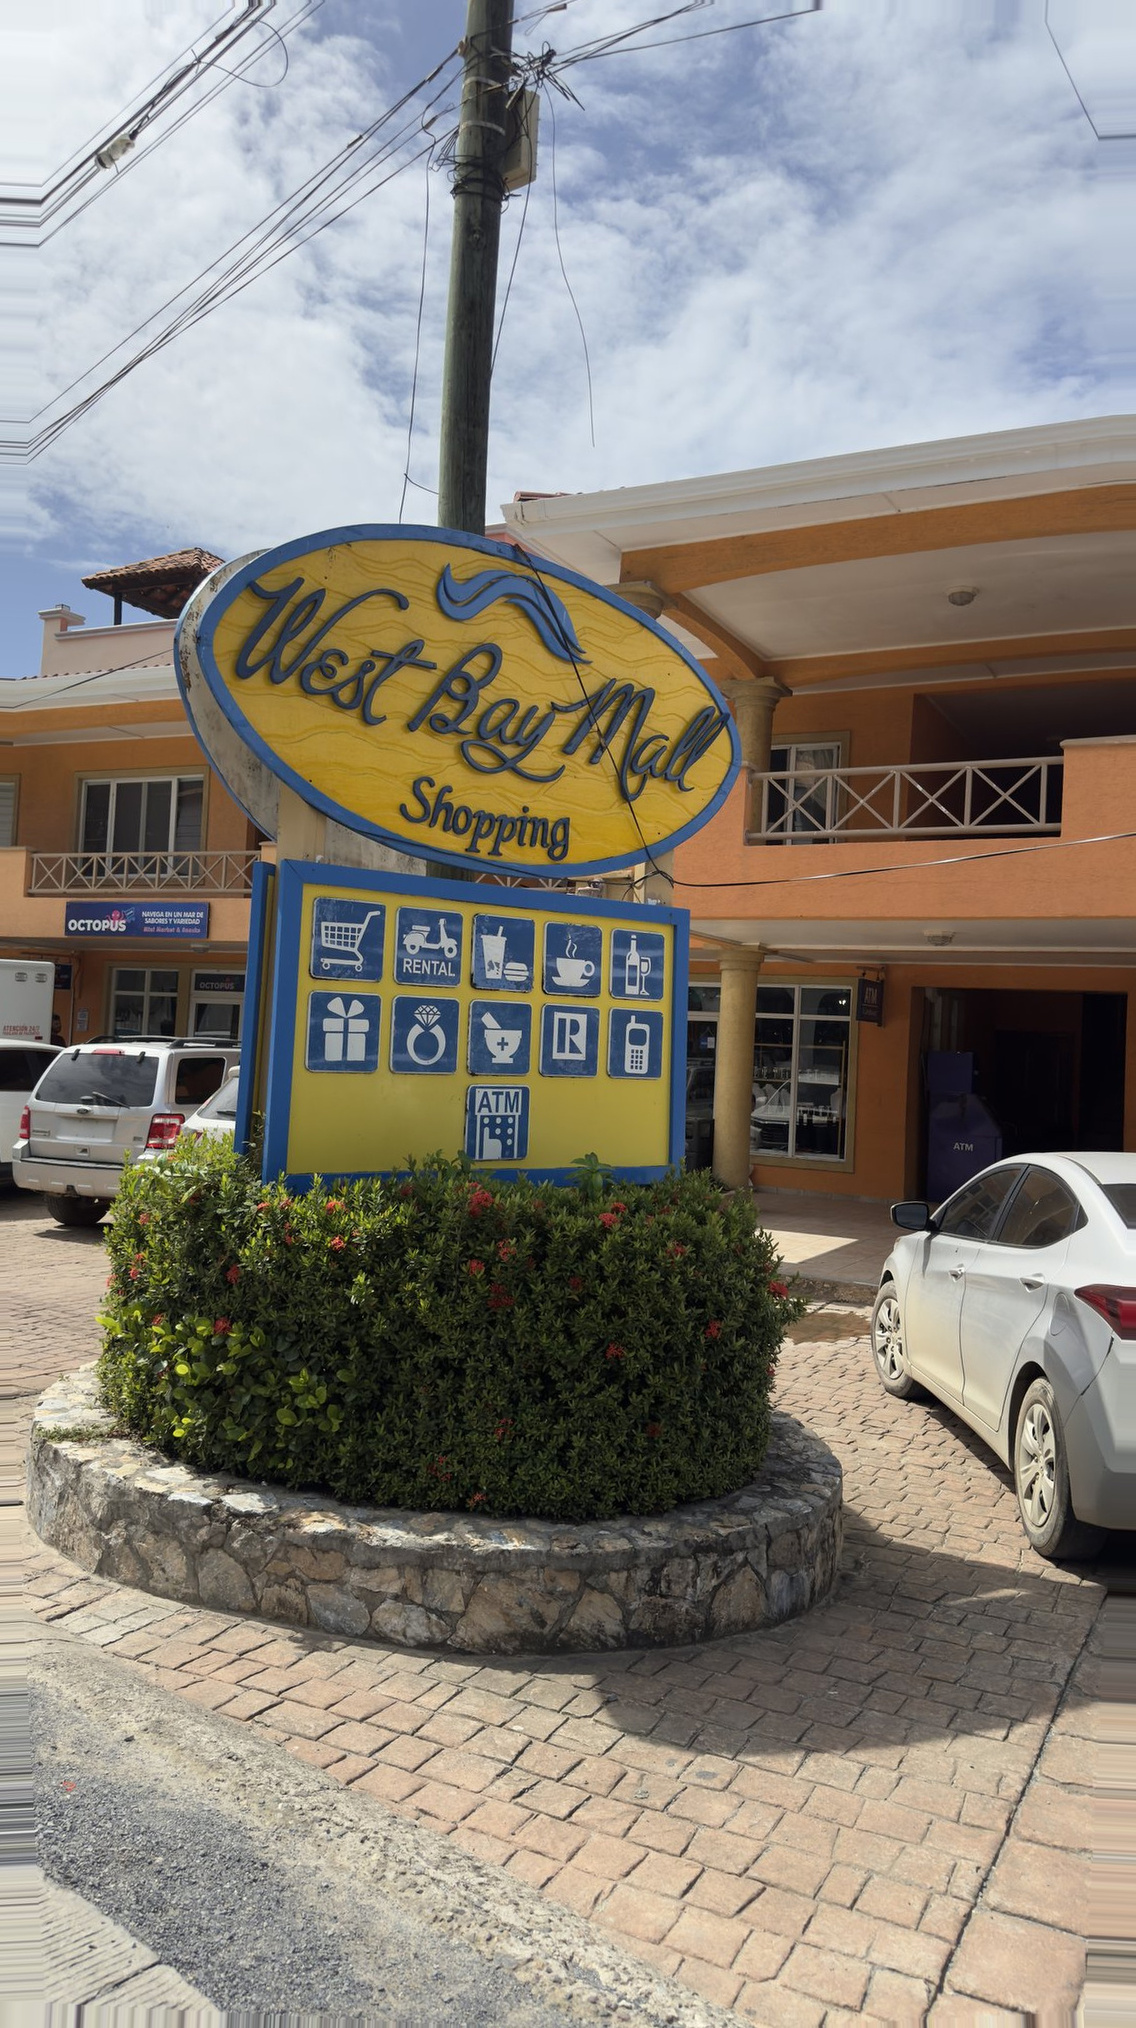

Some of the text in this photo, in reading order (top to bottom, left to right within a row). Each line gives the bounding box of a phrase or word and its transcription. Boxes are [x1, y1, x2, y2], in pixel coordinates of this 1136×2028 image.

[234, 575, 730, 801] West Bay Mall
[400, 776, 571, 863] Shopping
[68, 919, 127, 932] OCTOPUS
[403, 959, 456, 977] RENTAL
[199, 981, 235, 990] OCTOPUS
[865, 987, 878, 1005] ATM
[477, 1091, 521, 1114] ATM
[953, 1142, 974, 1152] ATM
